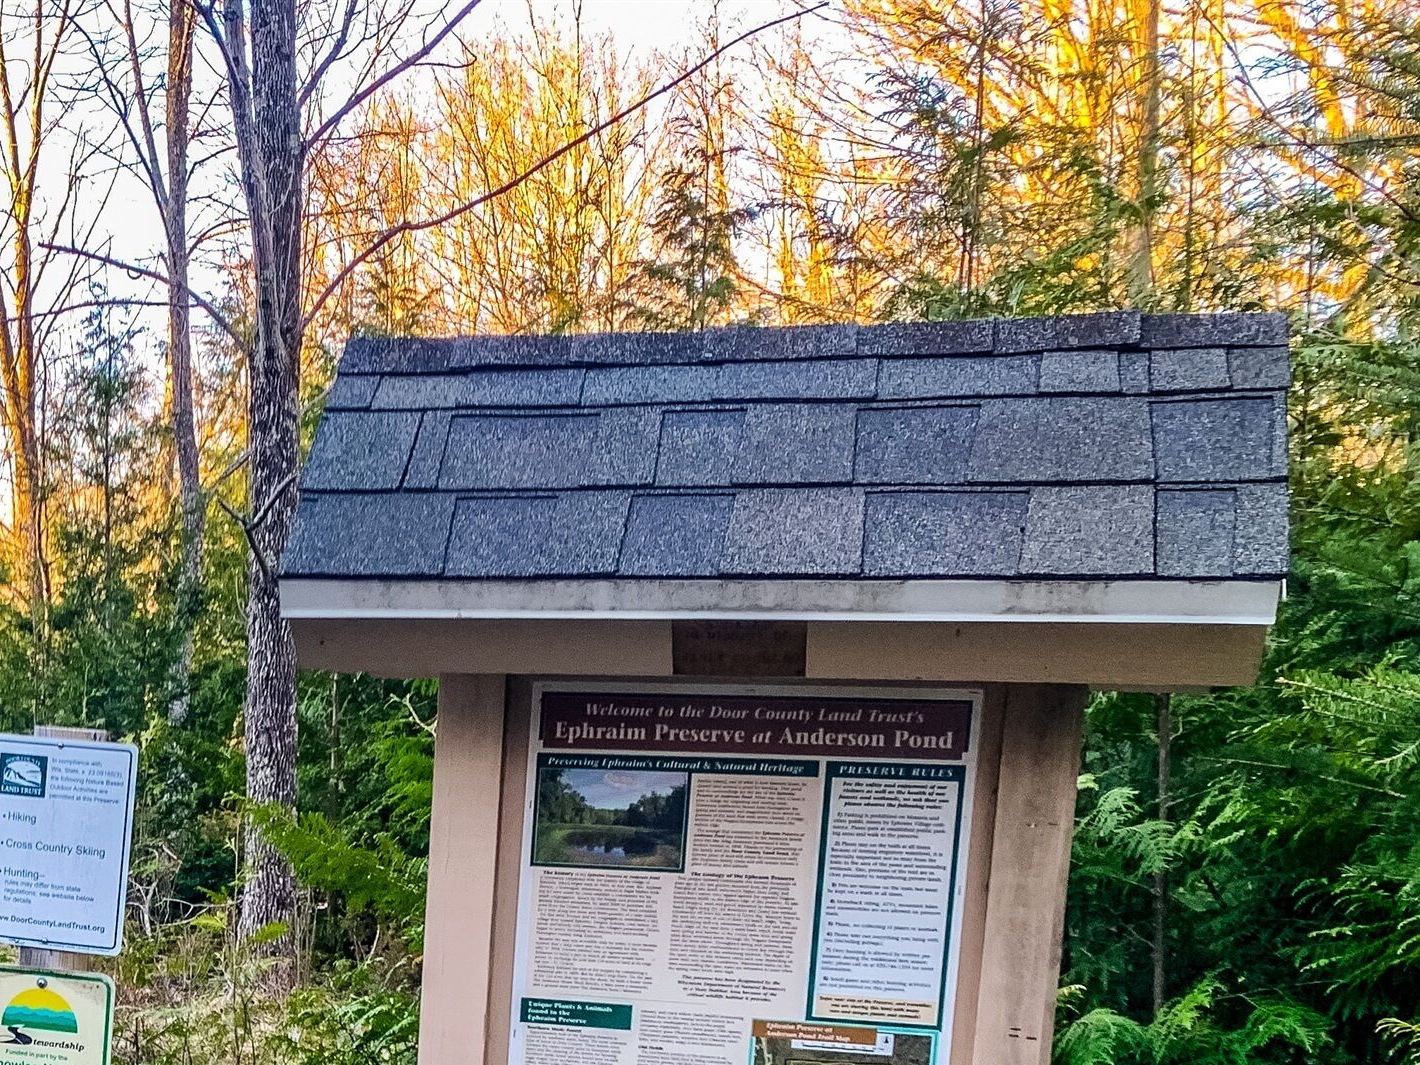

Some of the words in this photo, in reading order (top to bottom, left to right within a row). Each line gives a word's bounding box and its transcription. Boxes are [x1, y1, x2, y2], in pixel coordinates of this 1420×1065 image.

[585, 703, 653, 717] Welcome
[658, 705, 674, 718] to
[679, 705, 702, 718] the
[709, 706, 749, 719] Door
[754, 707, 814, 724] County
[819, 708, 863, 722] Land
[869, 710, 924, 723] Trust's
[555, 721, 646, 744] Ephraim
[654, 723, 746, 743] Preserve
[752, 730, 771, 744] at
[779, 727, 885, 748] Anderson
[894, 730, 954, 749] Pond
[548, 757, 599, 768] Preserving
[601, 758, 653, 769] Ephraim's
[655, 759, 700, 770] Cultural
[703, 761, 711, 770] &
[714, 761, 756, 771] Natural
[759, 762, 805, 774] Heritage
[839, 766, 905, 777] PRESERVE
[912, 767, 954, 777] RULES
[60, 776, 84, 785] following
[85, 777, 105, 786] Nature
[106, 779, 125, 787] Based
[1, 785, 20, 794] LAND
[21, 786, 42, 796] TRUST
[8, 811, 37, 825] Hiking
[5, 838, 33, 851] Cross
[35, 840, 73, 856] Country
[75, 844, 106, 859] Skiing
[20, 881, 34, 889] may
[34, 881, 50, 889] differ
[50, 884, 65, 892] from
[51, 893, 75, 901] website
[554, 1002, 576, 1010] Plants
[527, 1014, 557, 1022] Ephraim
[558, 1016, 587, 1024] Preserve
[766, 1022, 796, 1030] Ephraim
[796, 1024, 824, 1032] Preserve
[5, 1048, 28, 1057] Funded
[35, 1052, 49, 1060] part
[49, 1053, 57, 1061] by
